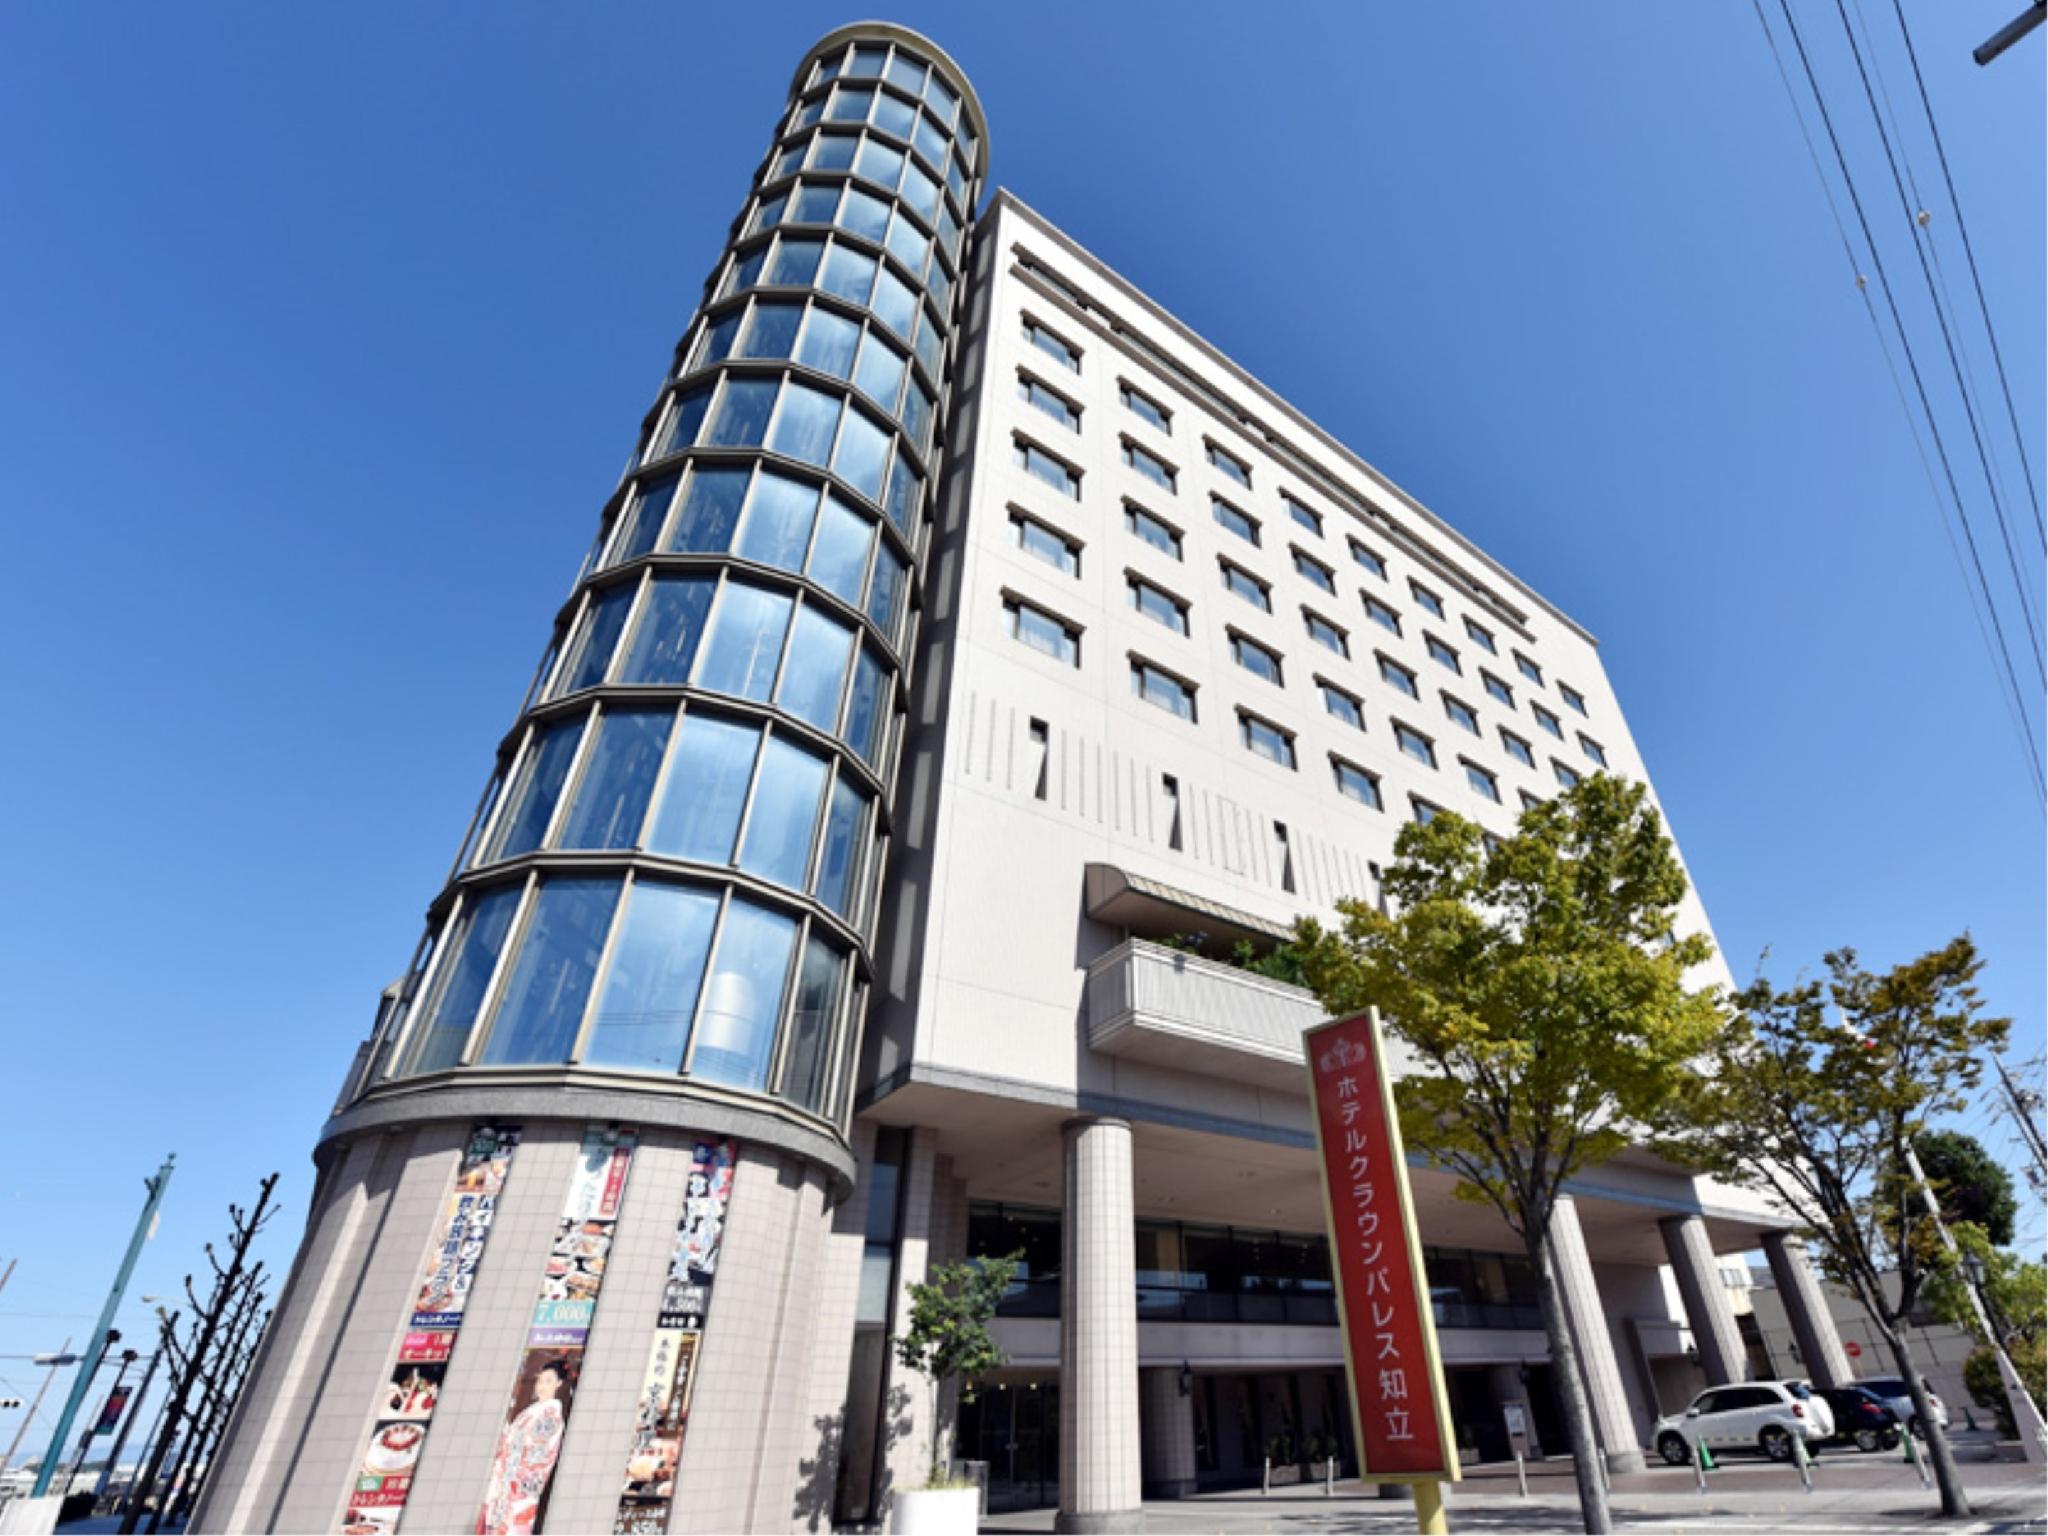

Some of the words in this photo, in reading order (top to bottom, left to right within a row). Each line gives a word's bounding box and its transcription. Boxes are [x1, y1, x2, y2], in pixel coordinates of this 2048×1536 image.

[1335, 1075, 1415, 1442] ホテルクラウンパレス知立
